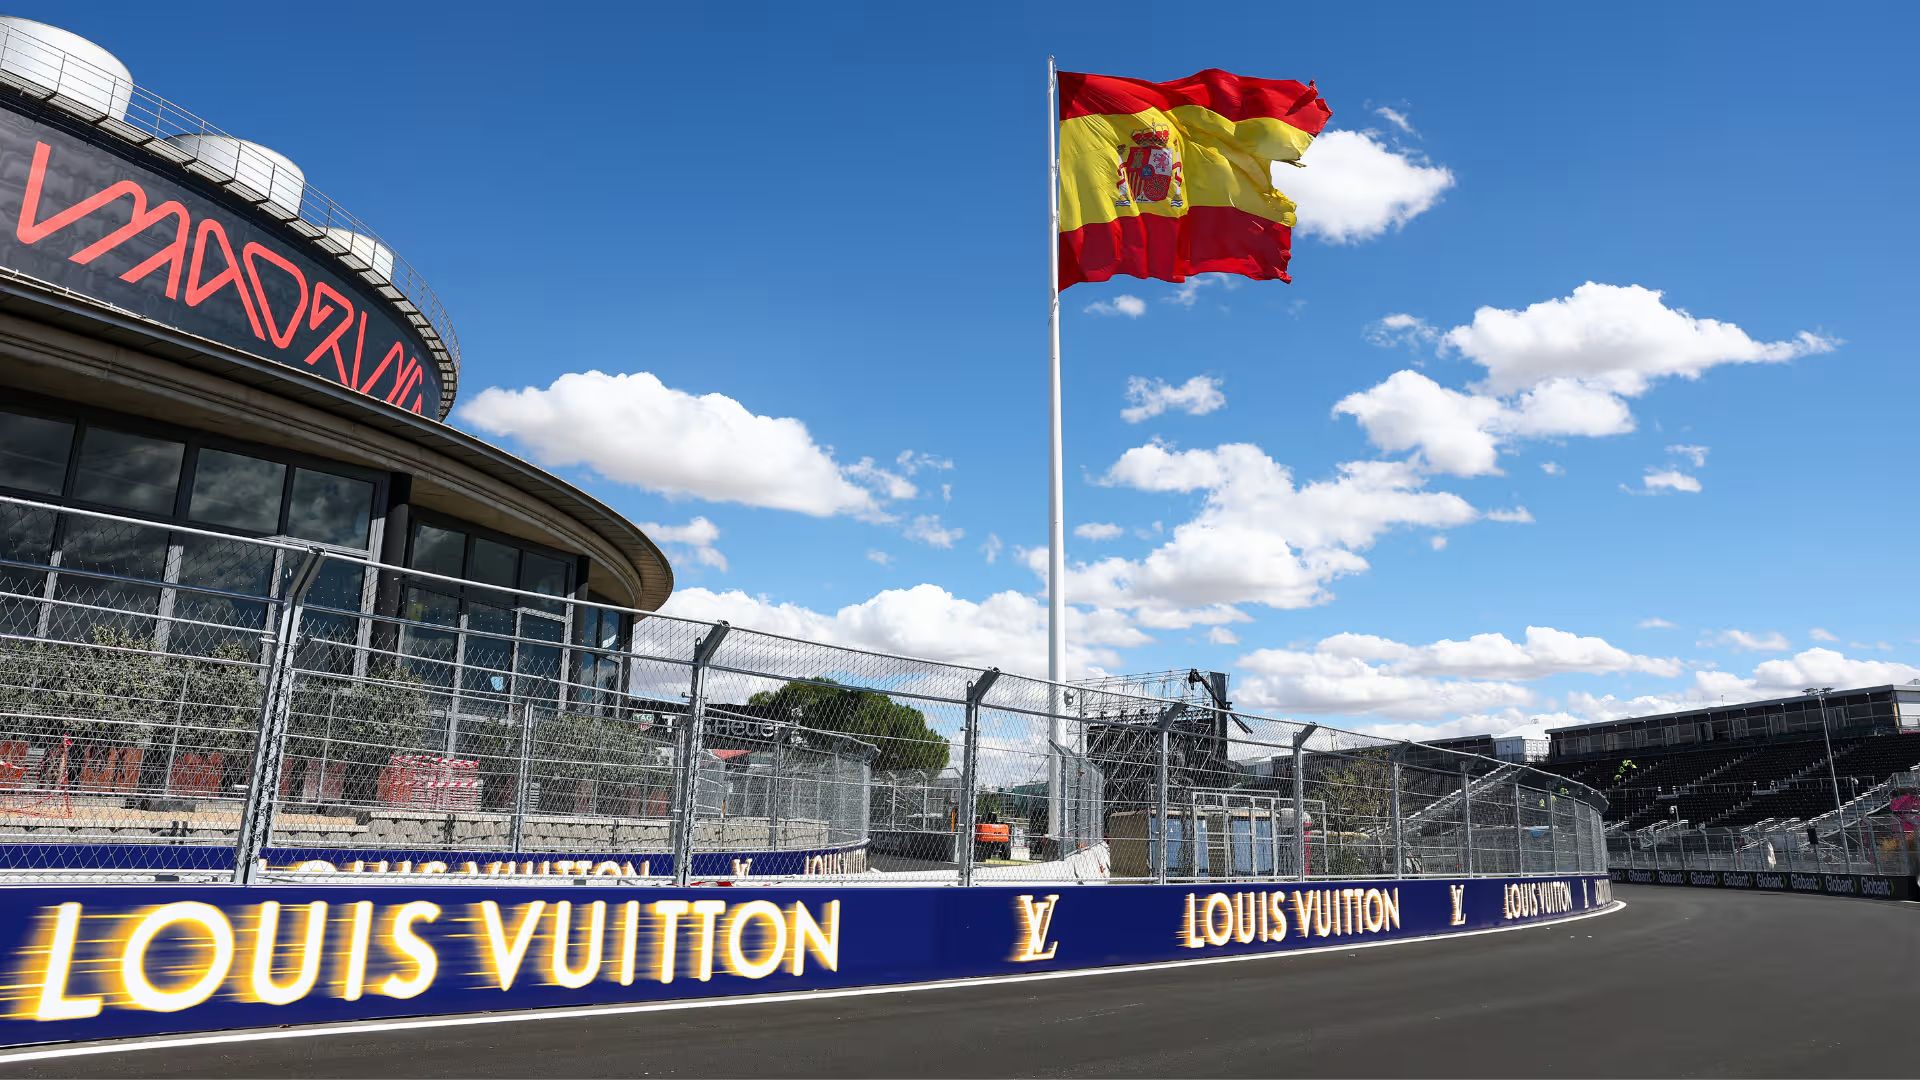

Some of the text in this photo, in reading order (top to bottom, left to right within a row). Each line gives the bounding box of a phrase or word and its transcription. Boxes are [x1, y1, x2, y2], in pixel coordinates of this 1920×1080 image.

[1628, 870, 1652, 882] Globant
[1658, 871, 1683, 884] Globant
[1690, 872, 1716, 885] Globant
[1723, 872, 1750, 887] Globant
[1756, 874, 1784, 888] Globant
[1790, 874, 1818, 890] Globant
[1825, 875, 1854, 892] Globant
[1860, 877, 1891, 896] Globant
[1503, 883, 1538, 920] LOUIS
[1539, 881, 1573, 914] VUITTON
[1185, 888, 1400, 949] LOUIS VUITTON
[1016, 894, 1060, 962] LV
[32, 899, 841, 1021] LOUIS VUITTON
